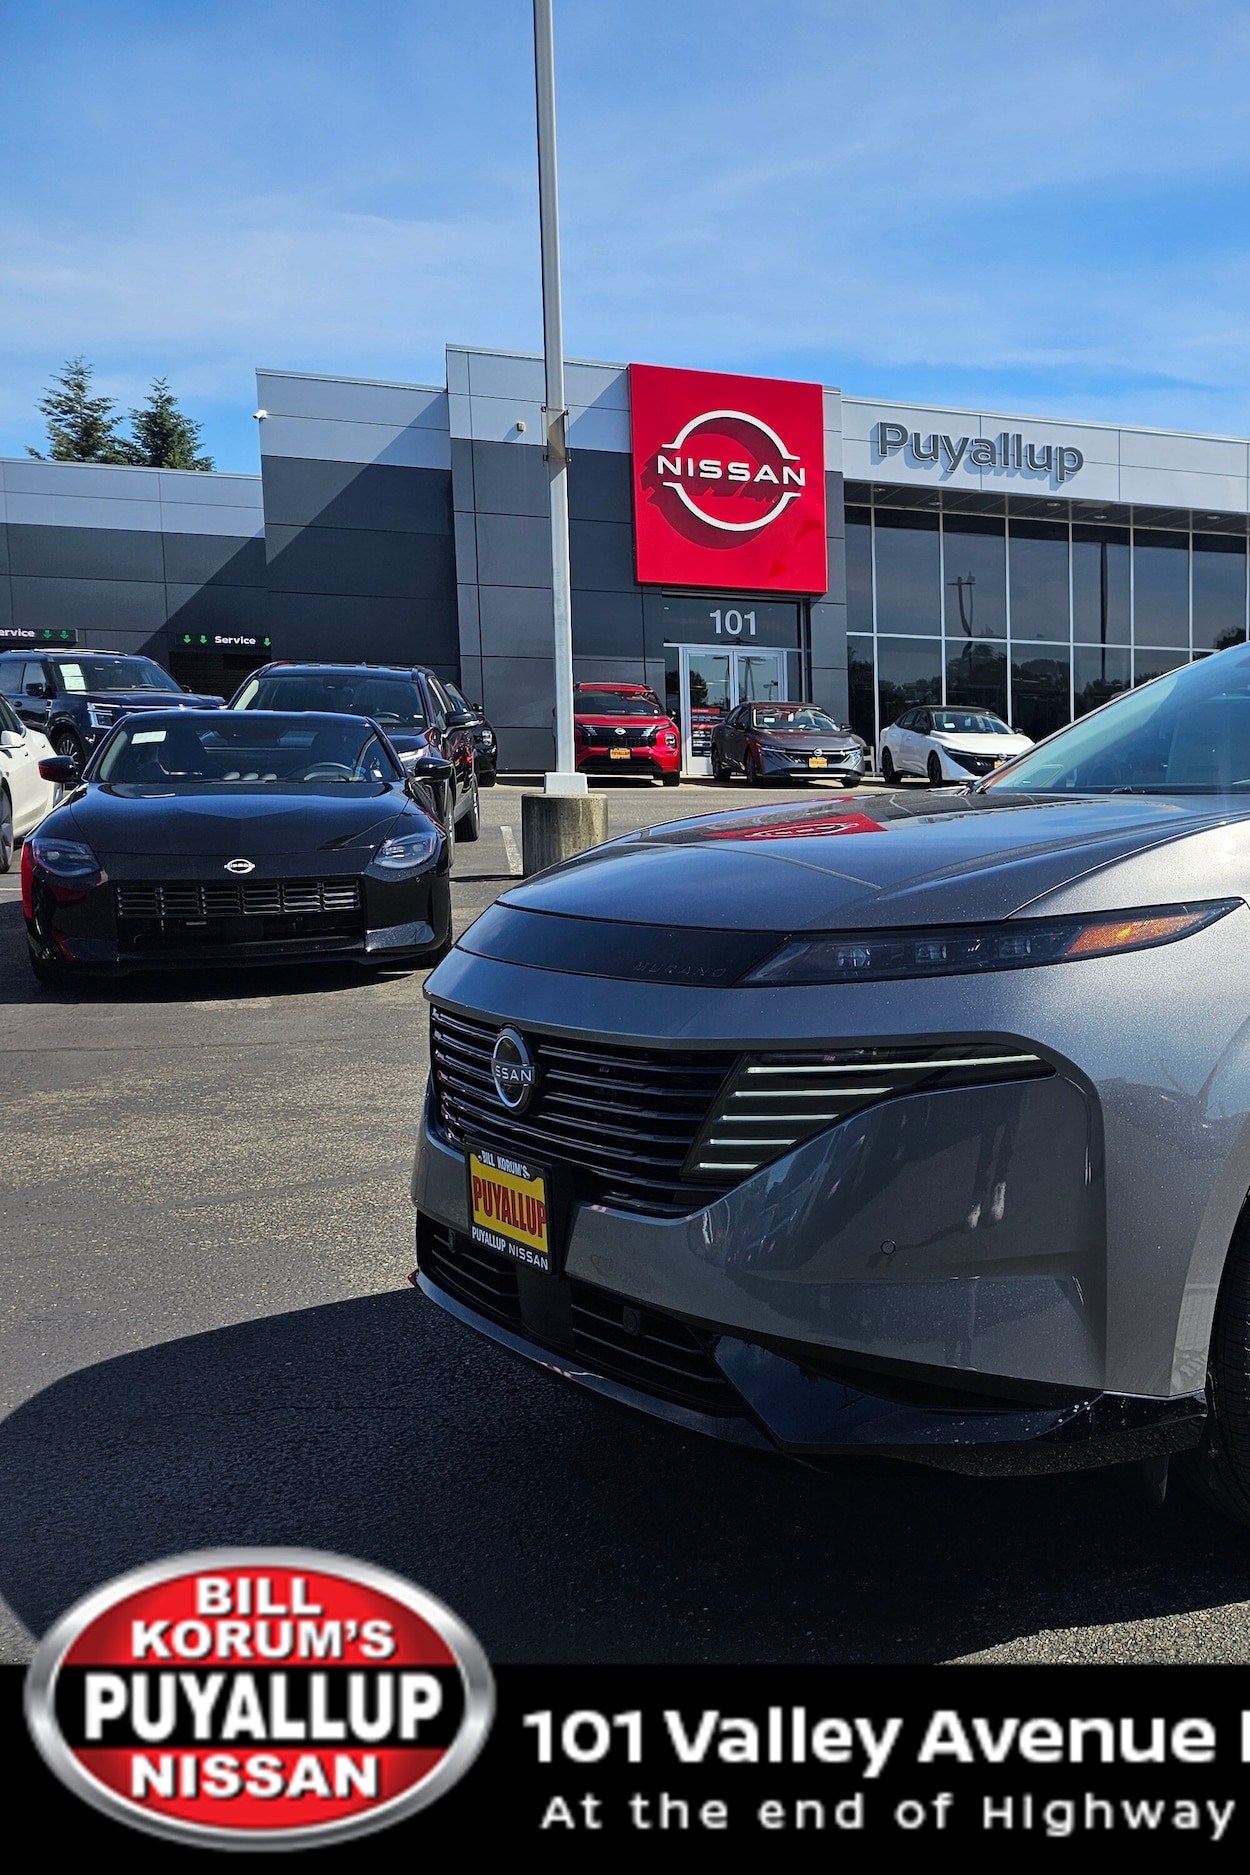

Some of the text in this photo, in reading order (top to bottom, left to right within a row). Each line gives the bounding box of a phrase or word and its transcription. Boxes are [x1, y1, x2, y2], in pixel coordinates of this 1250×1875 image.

[877, 421, 1085, 483] Puyallup
[656, 454, 806, 487] NISSAN
[0, 627, 36, 639] ervice
[708, 608, 758, 637] 101
[214, 634, 257, 646] Service
[632, 960, 728, 979] MURANO
[494, 1064, 534, 1083] SSAN
[480, 1149, 529, 1180] BILL KORUM'S
[472, 1174, 547, 1239] PUYALLUP
[471, 1224, 549, 1272] PUYALLUP NISSAN
